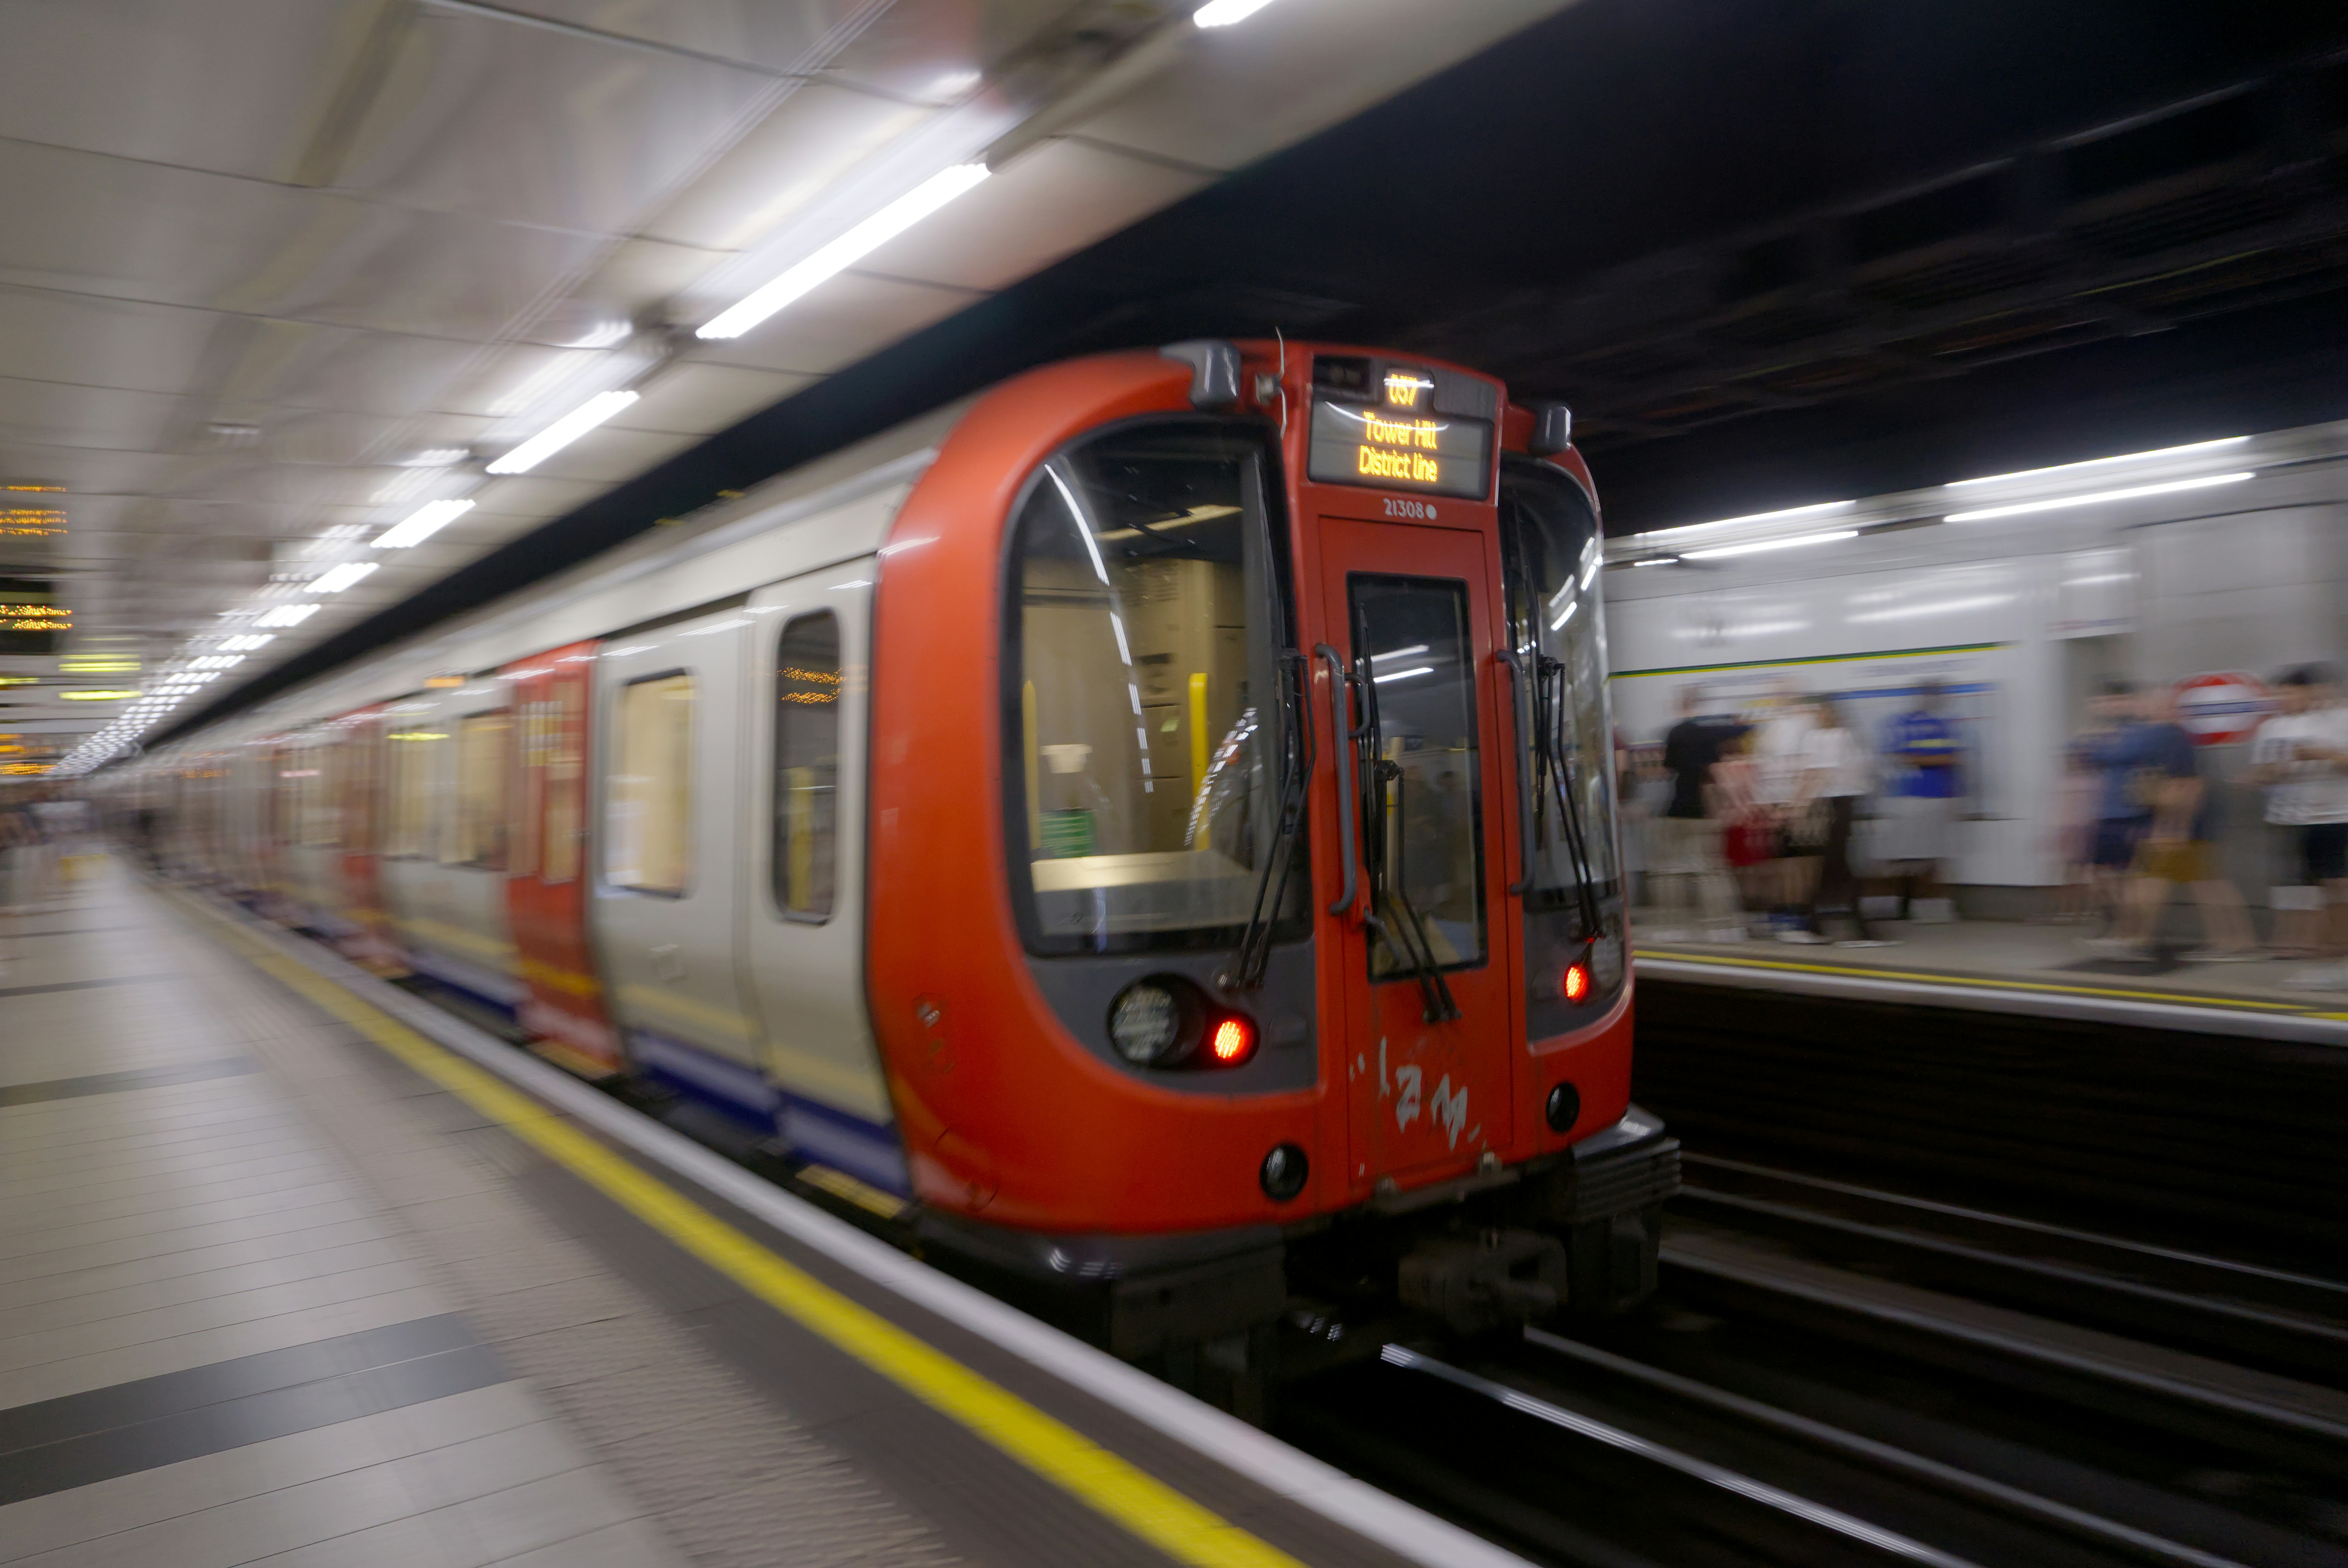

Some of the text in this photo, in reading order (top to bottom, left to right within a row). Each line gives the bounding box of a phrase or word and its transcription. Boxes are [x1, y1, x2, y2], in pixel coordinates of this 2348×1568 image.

[1364, 411, 1437, 449] Tower Hill
[1359, 445, 1437, 482] District line
[1383, 498, 1425, 519] 21308
